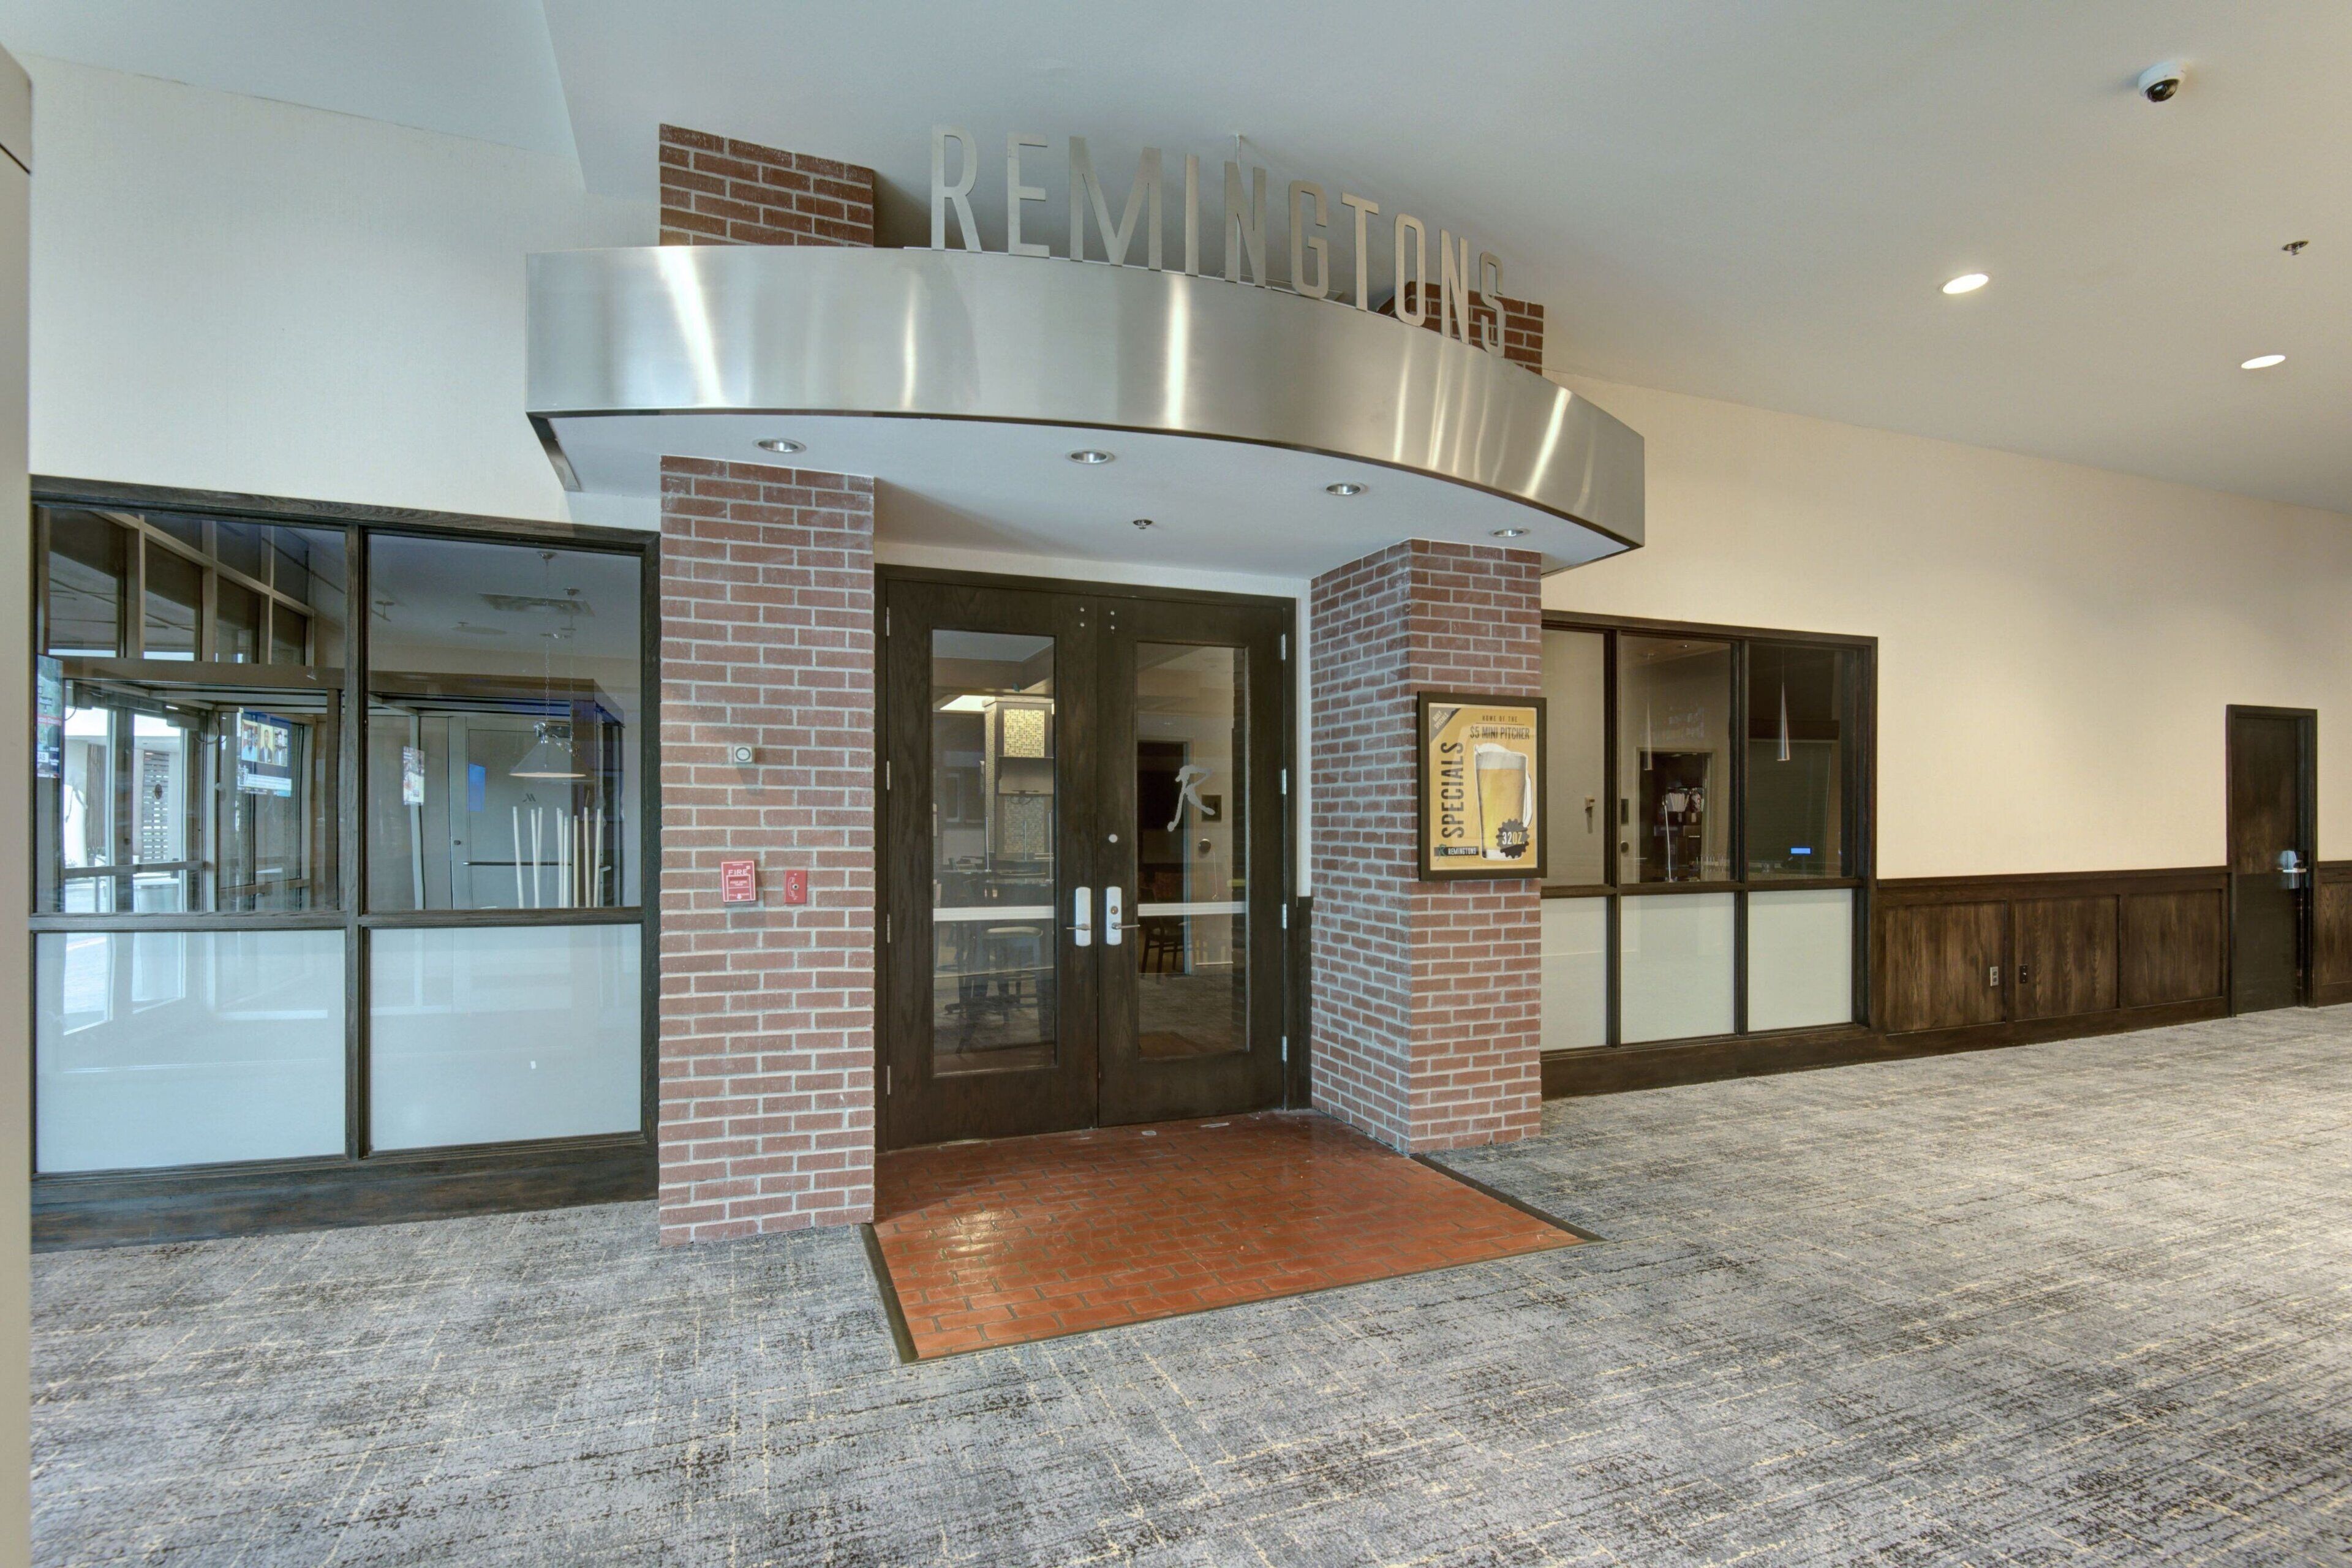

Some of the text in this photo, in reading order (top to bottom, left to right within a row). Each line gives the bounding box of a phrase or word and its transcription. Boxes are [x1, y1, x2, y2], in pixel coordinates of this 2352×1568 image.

[931, 126, 1506, 357] REMINGTONS
[1470, 726, 1530, 740] $5 MINI PITCHER
[1441, 742, 1464, 839] SPECIALS
